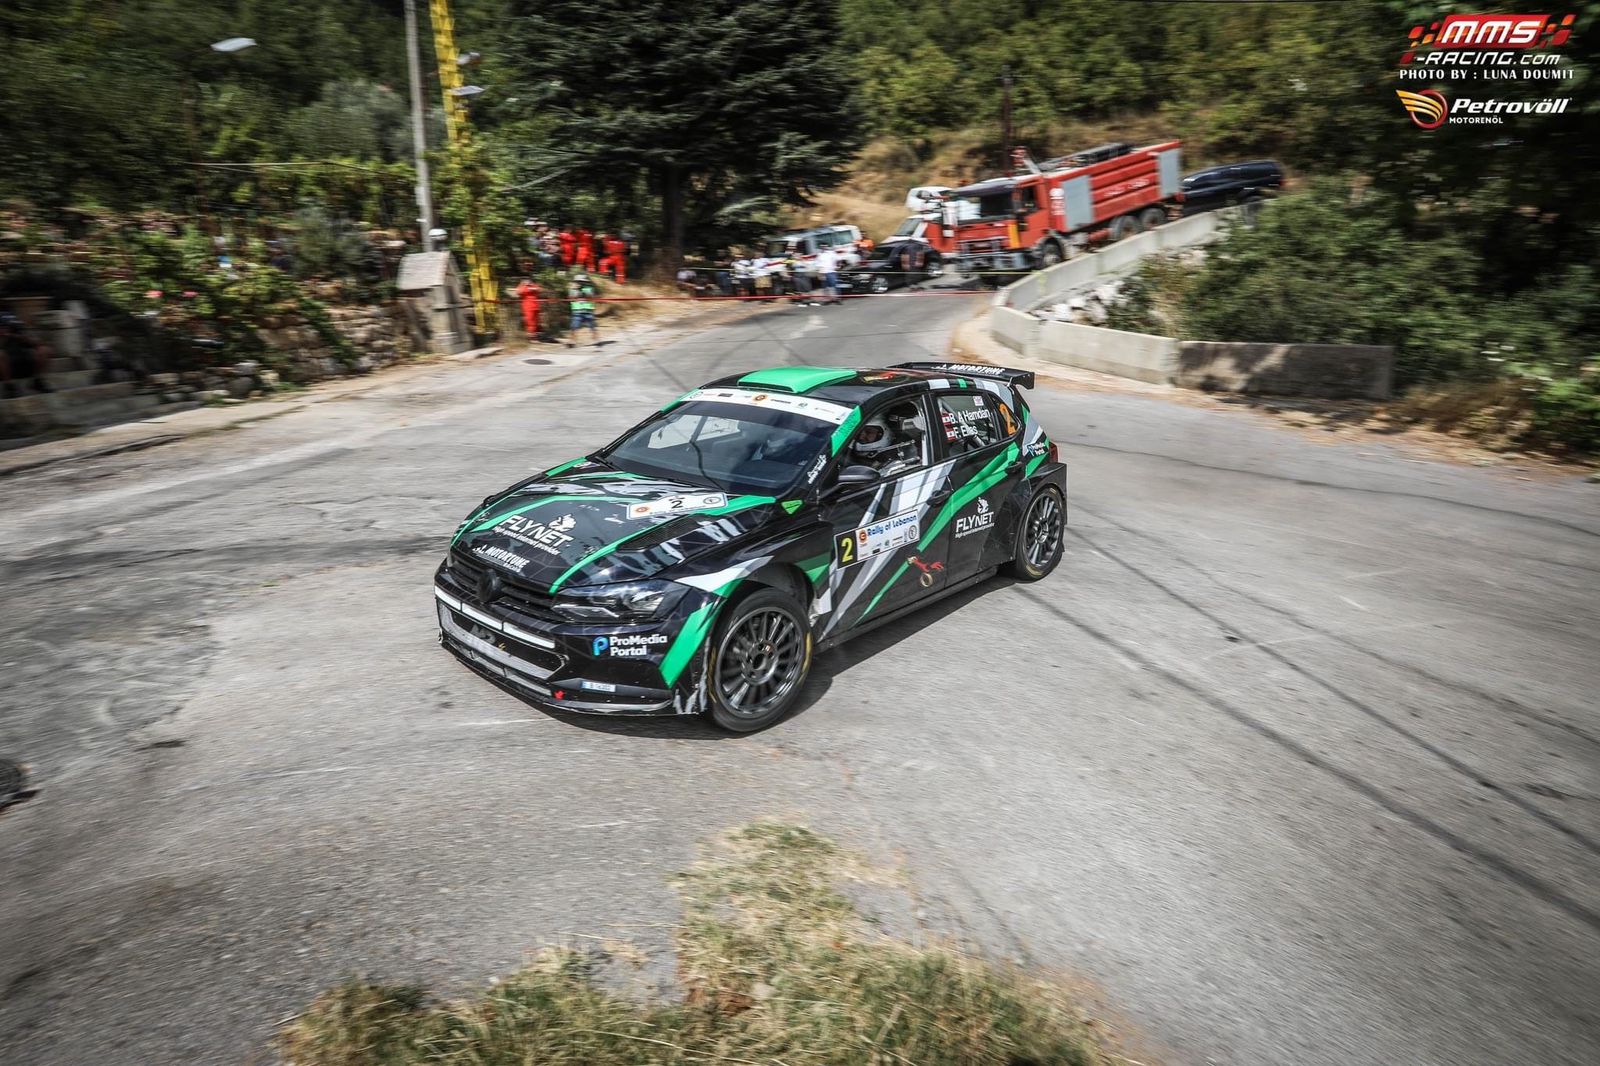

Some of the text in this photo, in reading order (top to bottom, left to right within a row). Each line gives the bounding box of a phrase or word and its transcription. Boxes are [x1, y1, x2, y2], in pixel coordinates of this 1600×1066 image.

[962, 408, 991, 421] Hamdan
[671, 500, 684, 509] 2
[499, 514, 575, 548] FLYNET
[867, 514, 918, 537] Rally of Lebanon
[955, 511, 995, 533] FLYNET
[841, 537, 854, 563] 2
[609, 633, 668, 647] ProMedia
[610, 645, 647, 657] Portal
